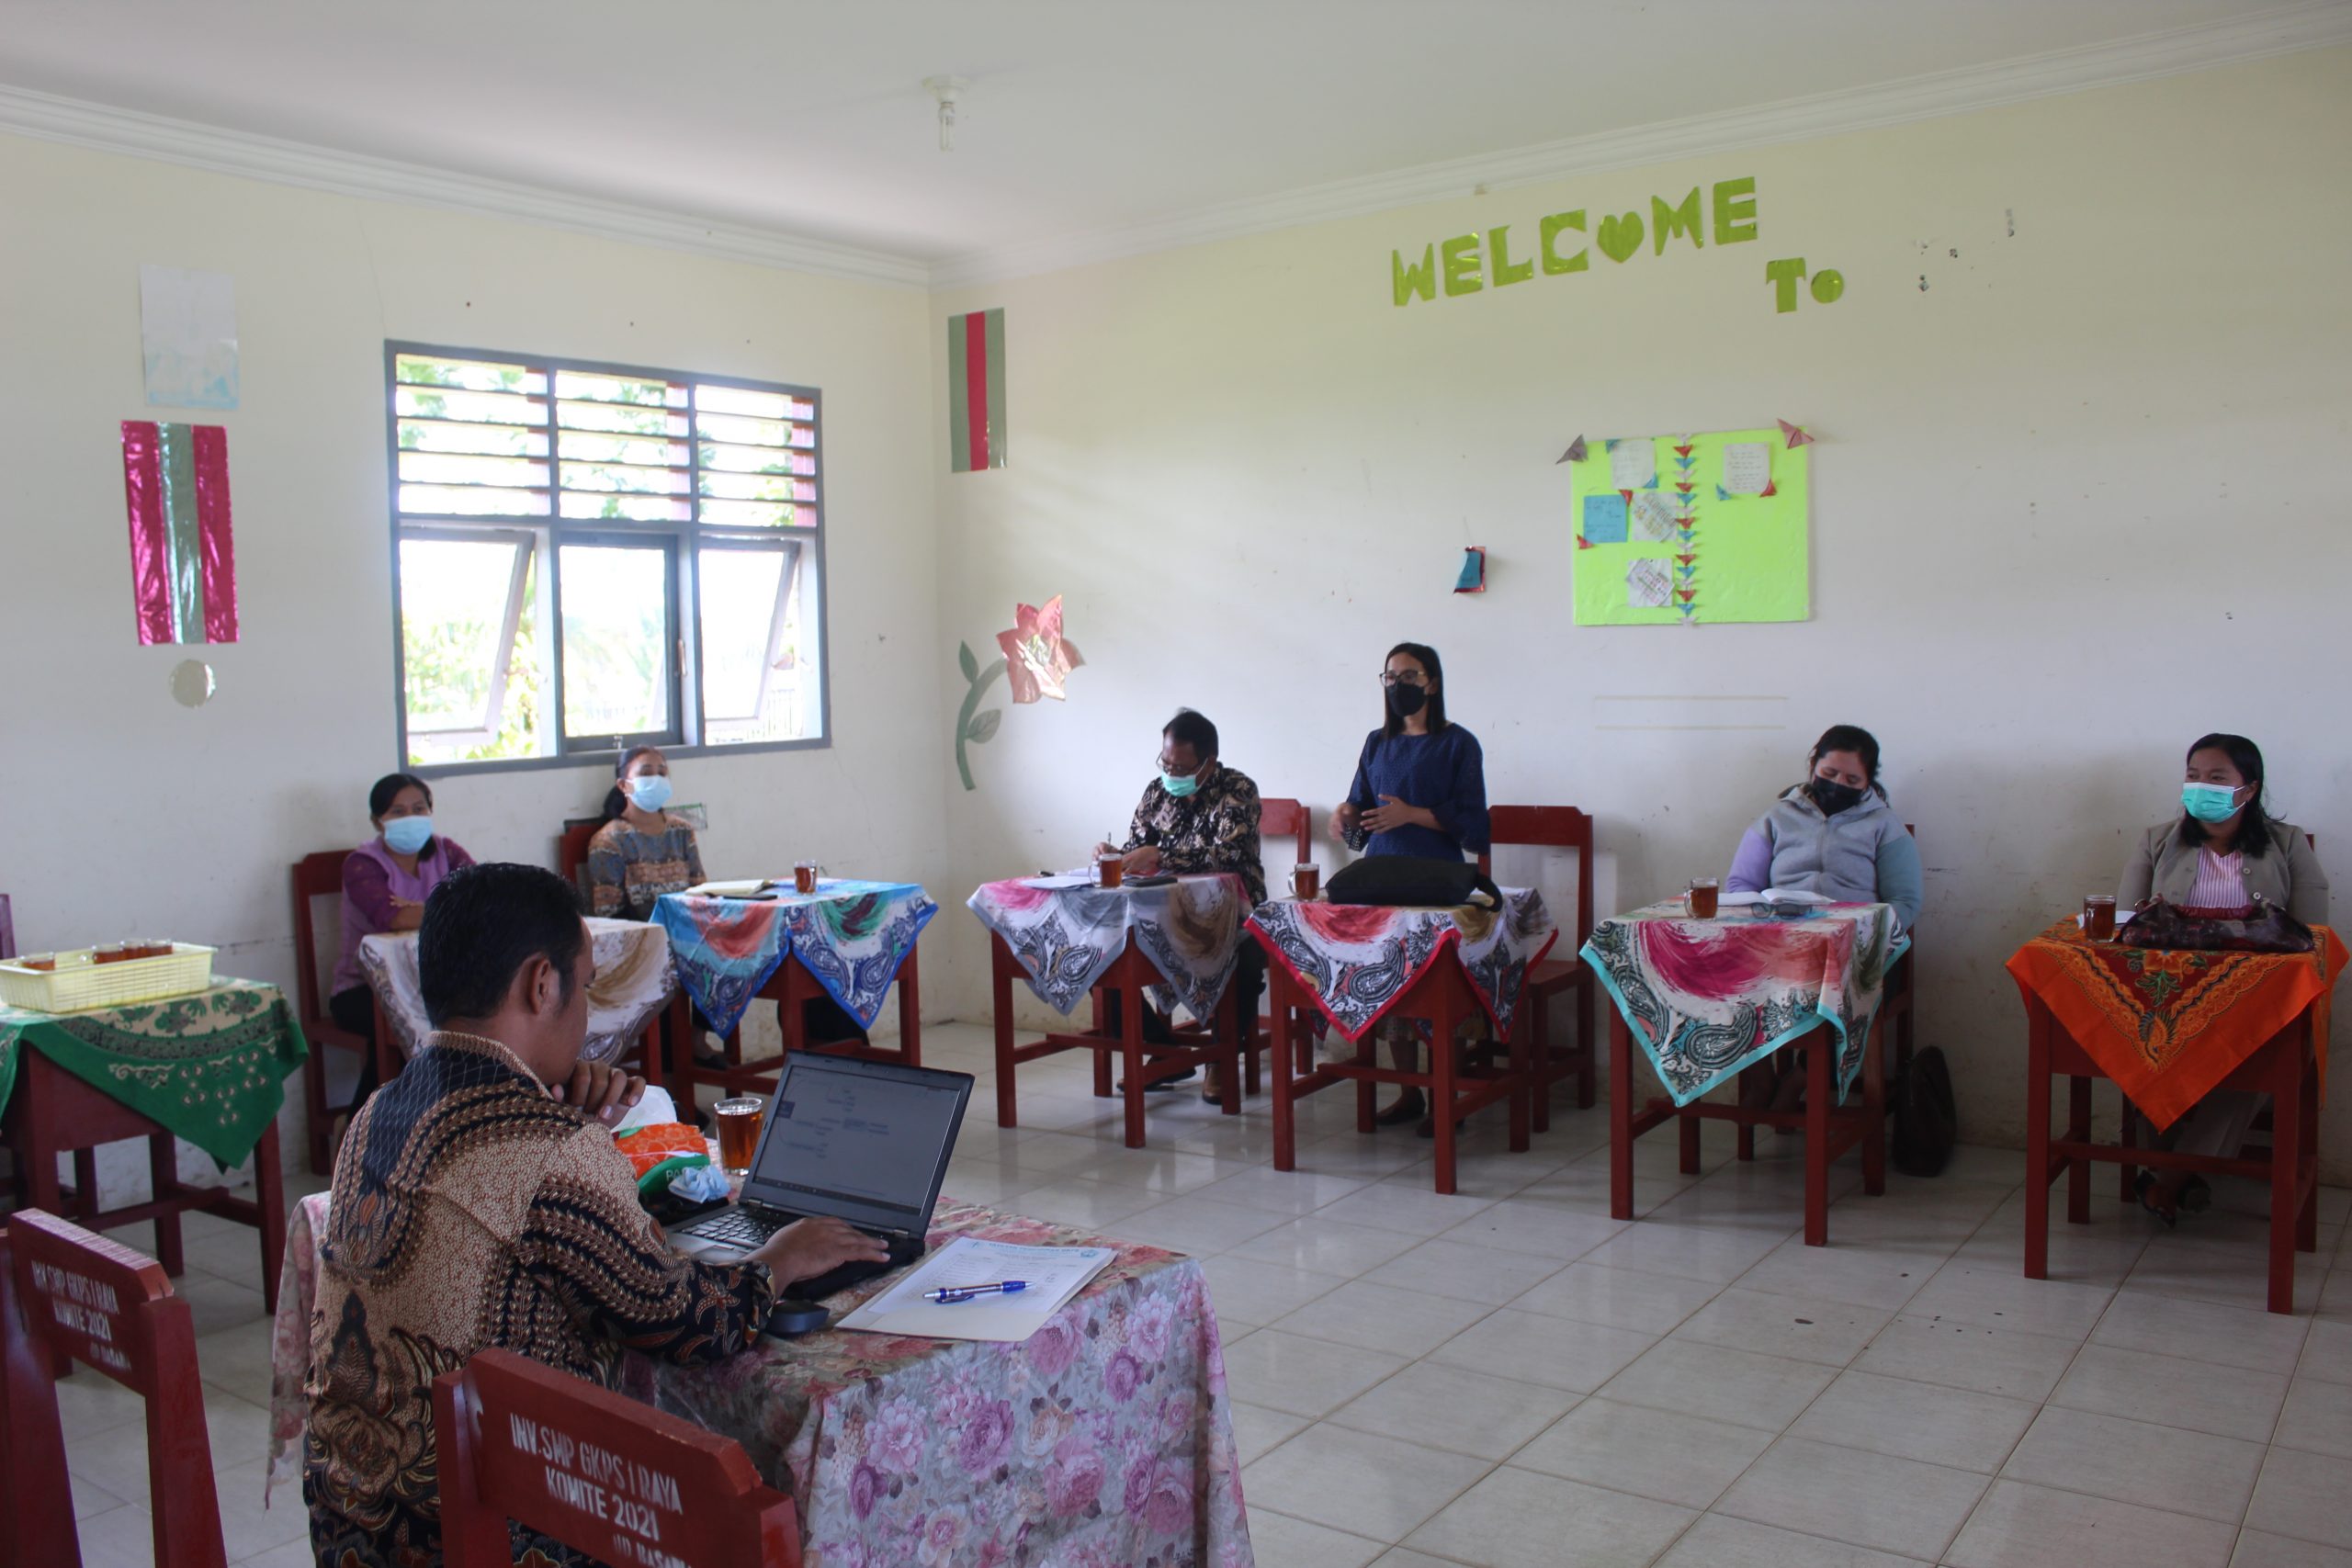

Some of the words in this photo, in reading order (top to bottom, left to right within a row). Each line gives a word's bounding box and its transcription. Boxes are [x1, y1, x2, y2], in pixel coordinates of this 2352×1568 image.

[544, 1464, 608, 1520] KOMITE
[611, 1493, 661, 1542] 2021
[579, 1440, 626, 1490] GKPS
[637, 1464, 684, 1516] RAYA
